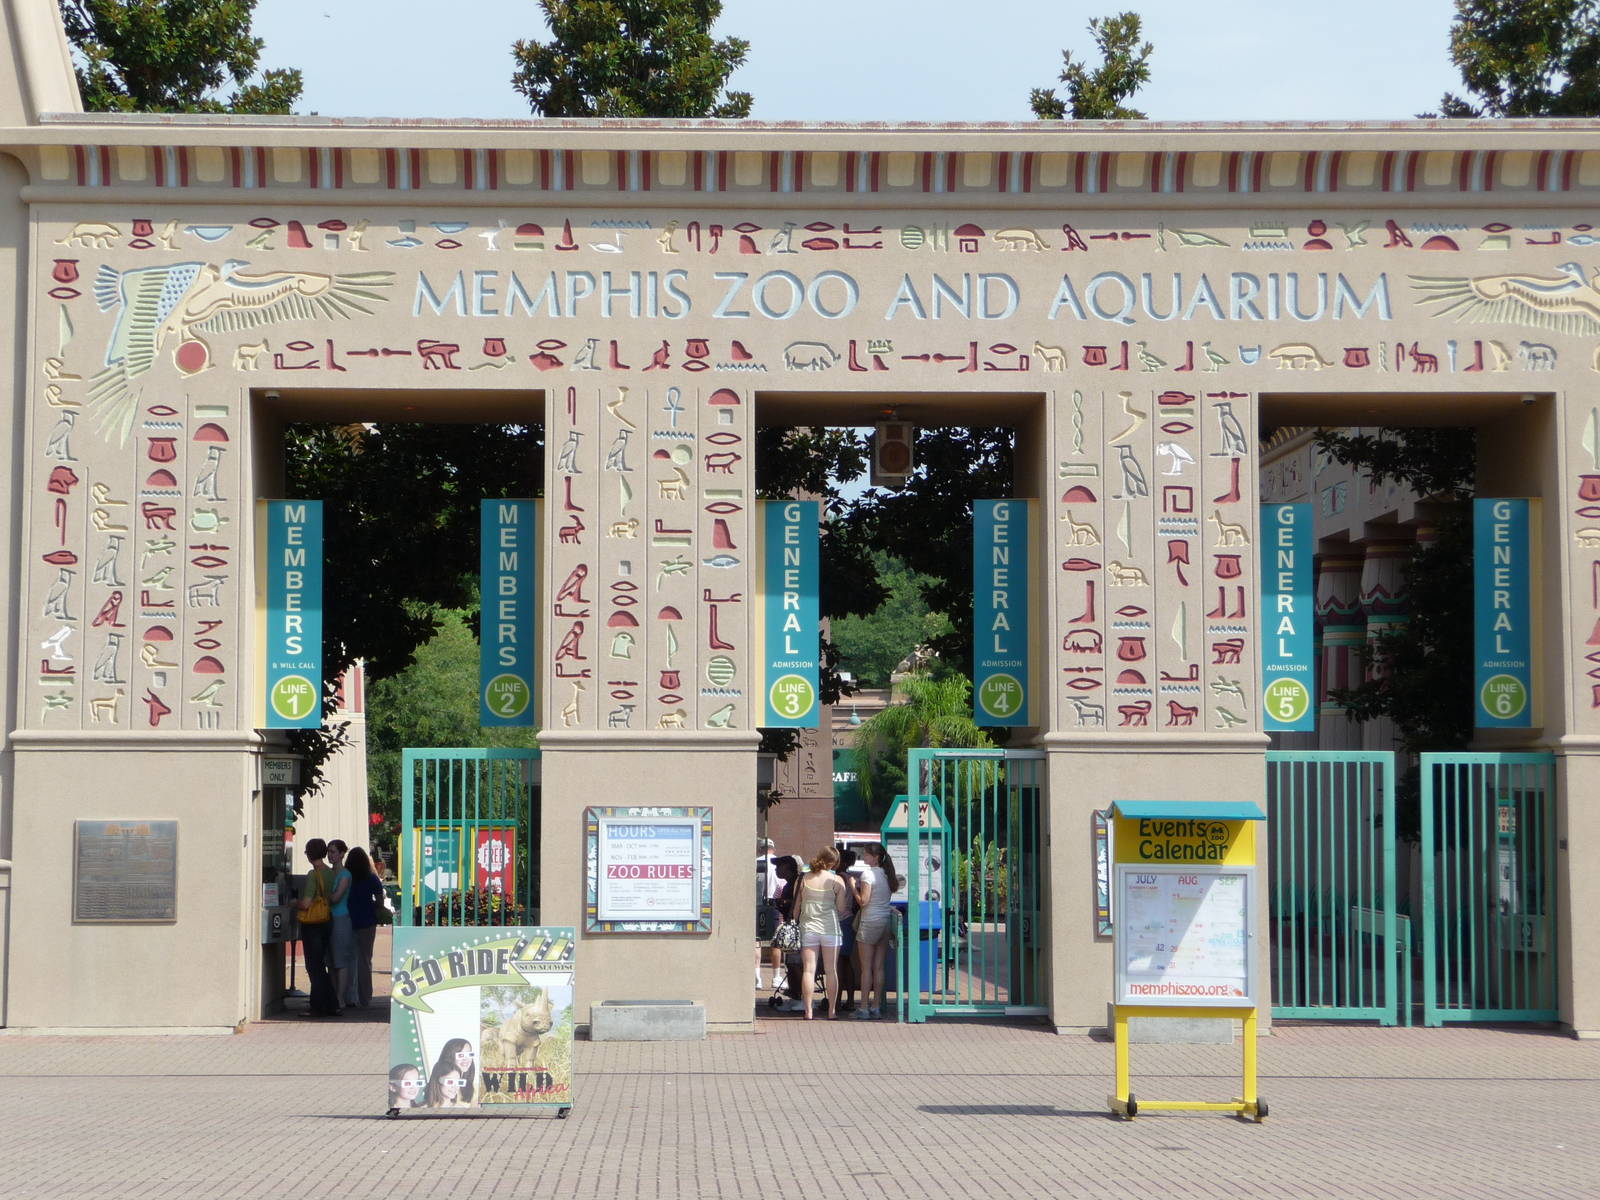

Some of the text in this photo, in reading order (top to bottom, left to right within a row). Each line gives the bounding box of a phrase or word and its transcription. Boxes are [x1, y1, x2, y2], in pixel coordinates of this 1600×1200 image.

[412, 268, 1393, 326] MEMPHIS ZOO AND AQUARIUM
[284, 505, 306, 655] MEMBERS
[498, 504, 518, 667] MEMBERS
[783, 503, 801, 654] GENERAL
[991, 502, 1010, 653] GENERAL
[1276, 505, 1296, 657] GENERAL
[1492, 501, 1512, 654] GENERAL
[772, 660, 813, 668] ADMISSION
[981, 660, 1023, 668] ADMISSION
[1266, 664, 1308, 672] ADMISSION
[1483, 660, 1525, 668] ADMISSION
[280, 684, 308, 694] LINE
[494, 682, 521, 692] LINE
[778, 683, 806, 693] LINE
[987, 682, 1015, 692] LINE
[1272, 686, 1300, 696] LINE
[1489, 683, 1518, 693] LINE
[287, 694, 298, 715] 1
[500, 693, 516, 713] 2
[785, 694, 800, 714] 3
[992, 693, 1010, 712] 4
[1279, 697, 1294, 718] 5
[1495, 694, 1511, 714] 6
[264, 760, 292, 770] MEMBERS
[269, 772, 285, 781] ONLY
[608, 825, 656, 838] HOURS
[1139, 818, 1207, 838] Events
[1139, 839, 1229, 860] Calendar
[608, 865, 693, 878] ZOO RULES
[1135, 874, 1158, 885] JULY
[395, 948, 511, 997] 3-D RIDE
[1130, 981, 1228, 996] memphiszoo.org
[482, 1072, 554, 1093] WILD
[513, 1082, 570, 1101] Africa
